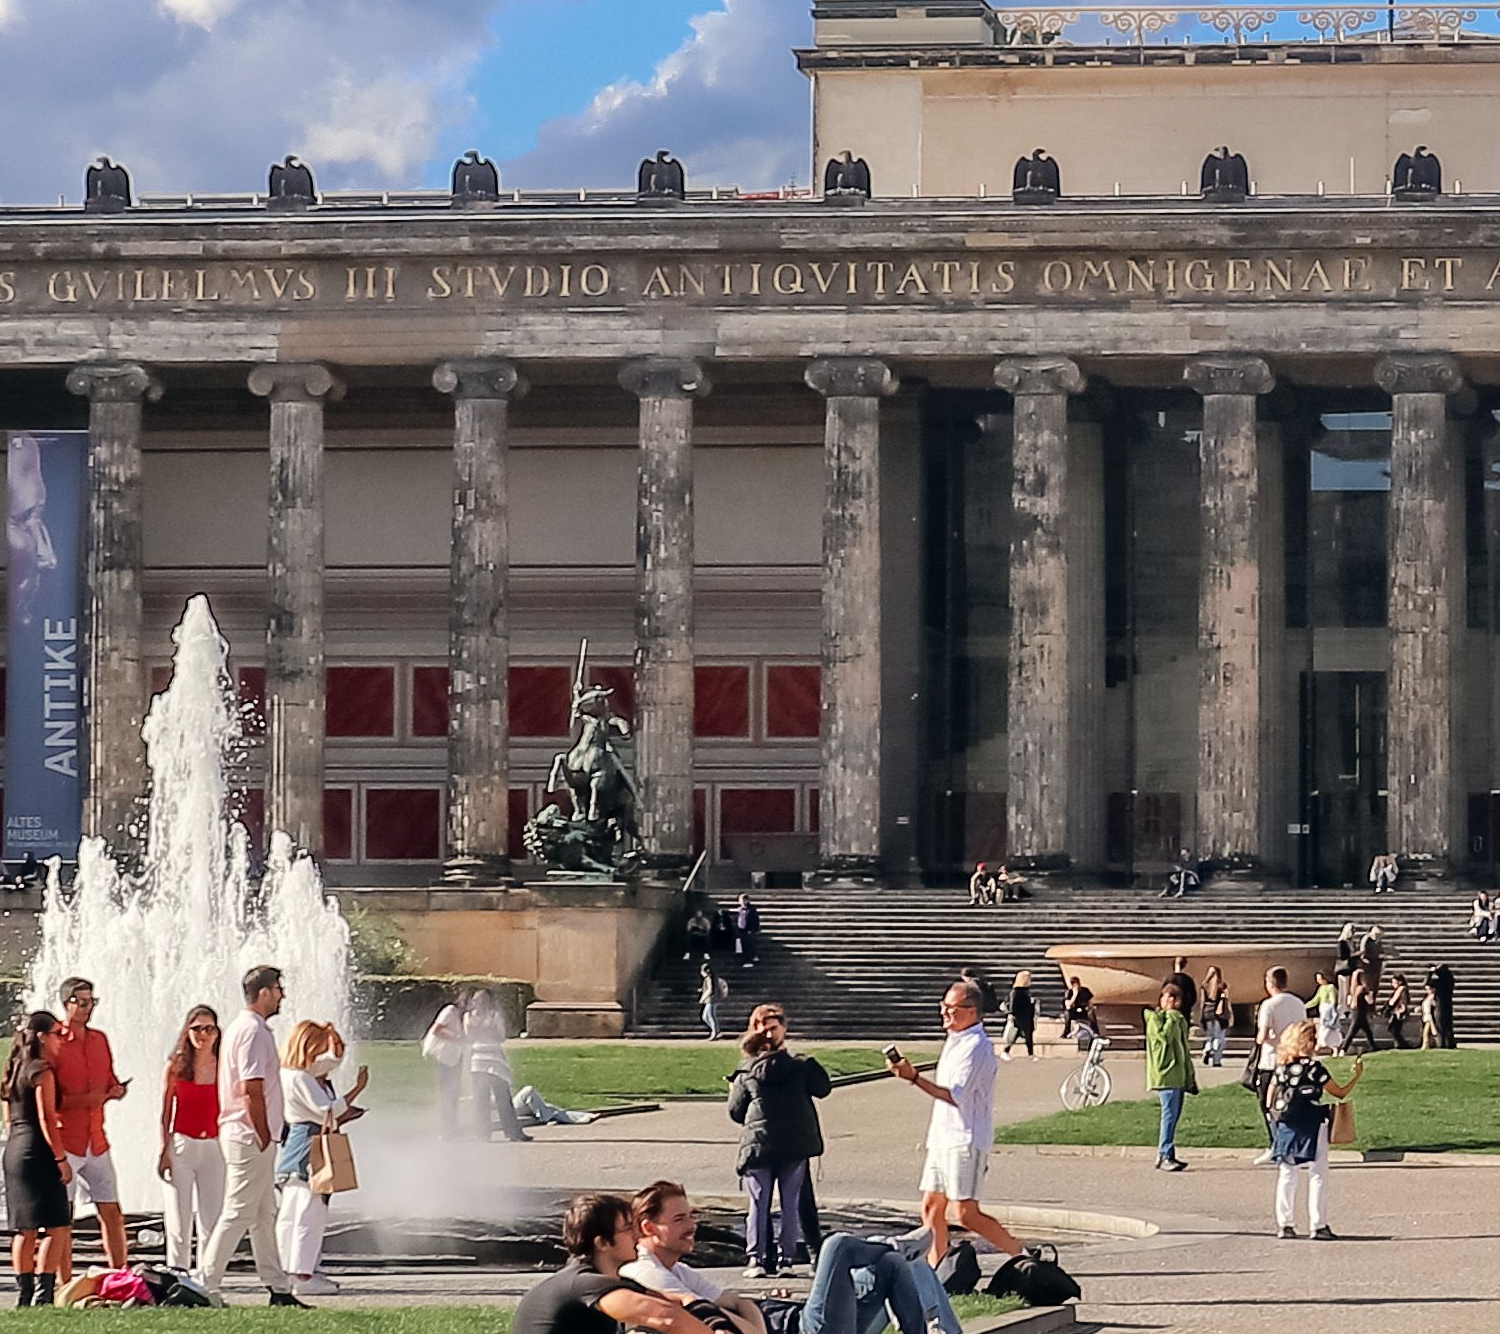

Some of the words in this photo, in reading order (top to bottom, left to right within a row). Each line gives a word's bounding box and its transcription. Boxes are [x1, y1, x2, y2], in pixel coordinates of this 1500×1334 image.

[48, 268, 316, 303] GVILELMVS
[345, 267, 396, 300] III
[427, 264, 610, 299] STVDIO
[642, 260, 1016, 298] ANTIQVITATIS
[1043, 257, 1373, 294] OMNIGENAE
[1400, 257, 1463, 291] ET
[43, 617, 78, 778] ANTIKE
[6, 816, 42, 828] ALTES
[7, 829, 59, 841] MUSEUM
